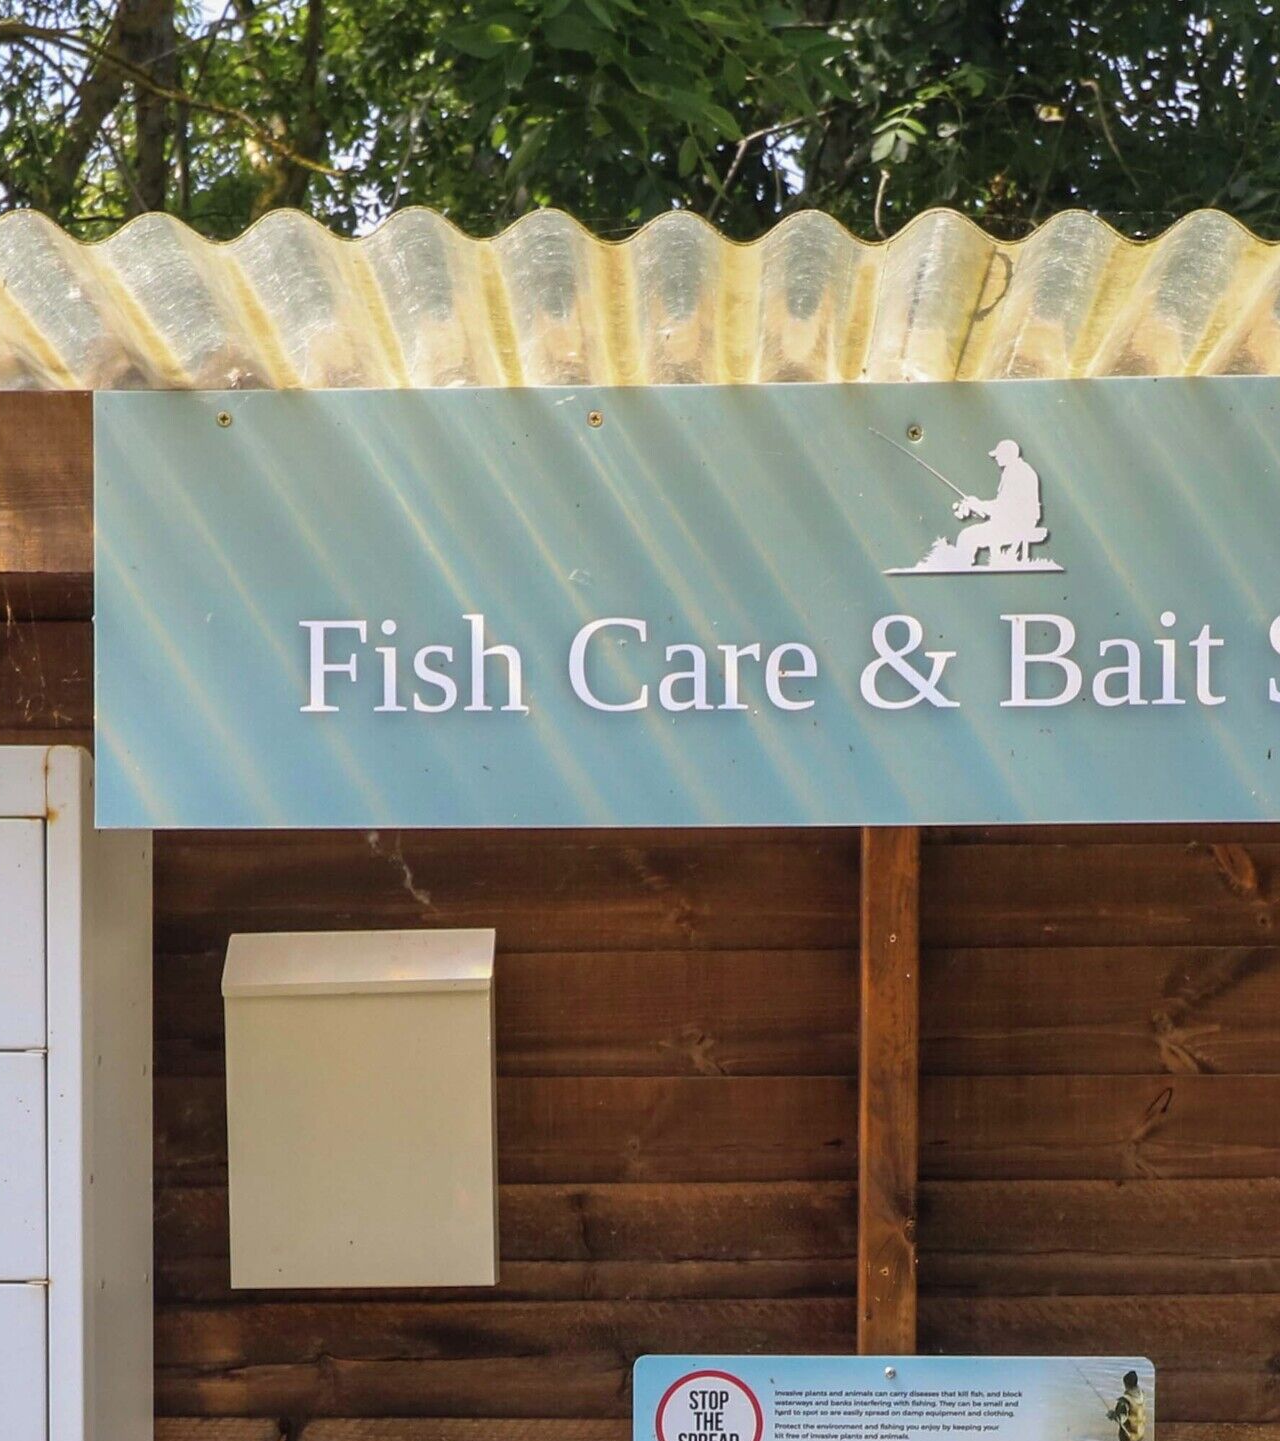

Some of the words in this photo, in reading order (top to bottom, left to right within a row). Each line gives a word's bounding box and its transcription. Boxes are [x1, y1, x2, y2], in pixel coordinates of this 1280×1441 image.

[299, 613, 530, 713] Fish
[569, 617, 817, 712] Care
[860, 614, 961, 710] &
[1000, 611, 1226, 707] Bait
[805, 1390, 827, 1398] plants
[689, 1390, 729, 1410] STOP
[775, 1400, 813, 1408] waterways
[854, 1400, 891, 1408] interfering
[912, 1400, 936, 1408] fishing.
[940, 1400, 955, 1408] They
[803, 1409, 818, 1417] spot
[843, 1409, 862, 1417] easily
[865, 1409, 889, 1417] spread
[903, 1410, 923, 1418] damp
[926, 1410, 965, 1418] equipment
[694, 1412, 723, 1431] THE
[881, 1423, 904, 1431] fishing
[840, 1433, 862, 1441] plants
